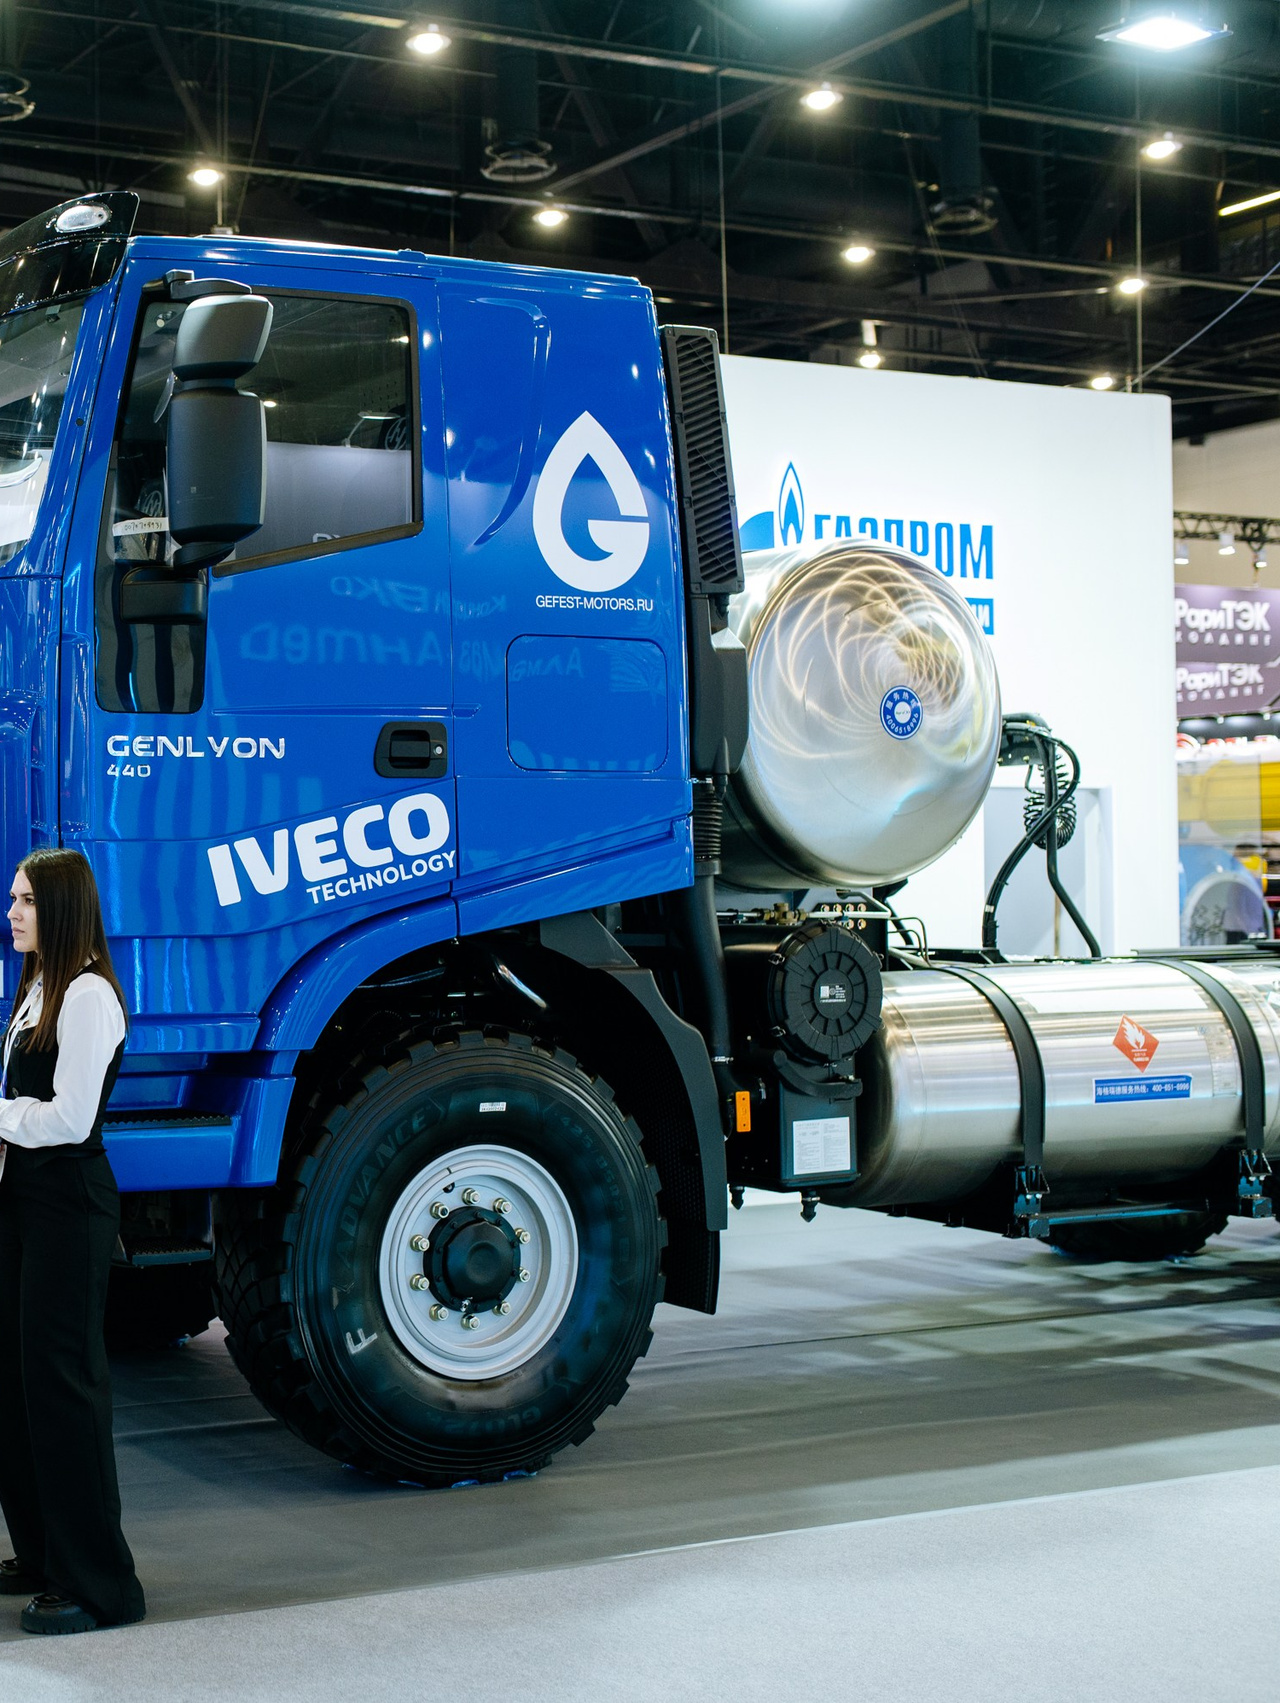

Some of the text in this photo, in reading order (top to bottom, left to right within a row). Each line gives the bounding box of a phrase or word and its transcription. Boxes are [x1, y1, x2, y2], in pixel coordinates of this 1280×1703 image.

[535, 595, 654, 611] GEFEST-MOTORS.RU
[106, 735, 286, 759] GENLYON
[106, 763, 151, 777] 440
[207, 793, 450, 907] IVECO
[306, 850, 456, 904] TECHNOLOGY
